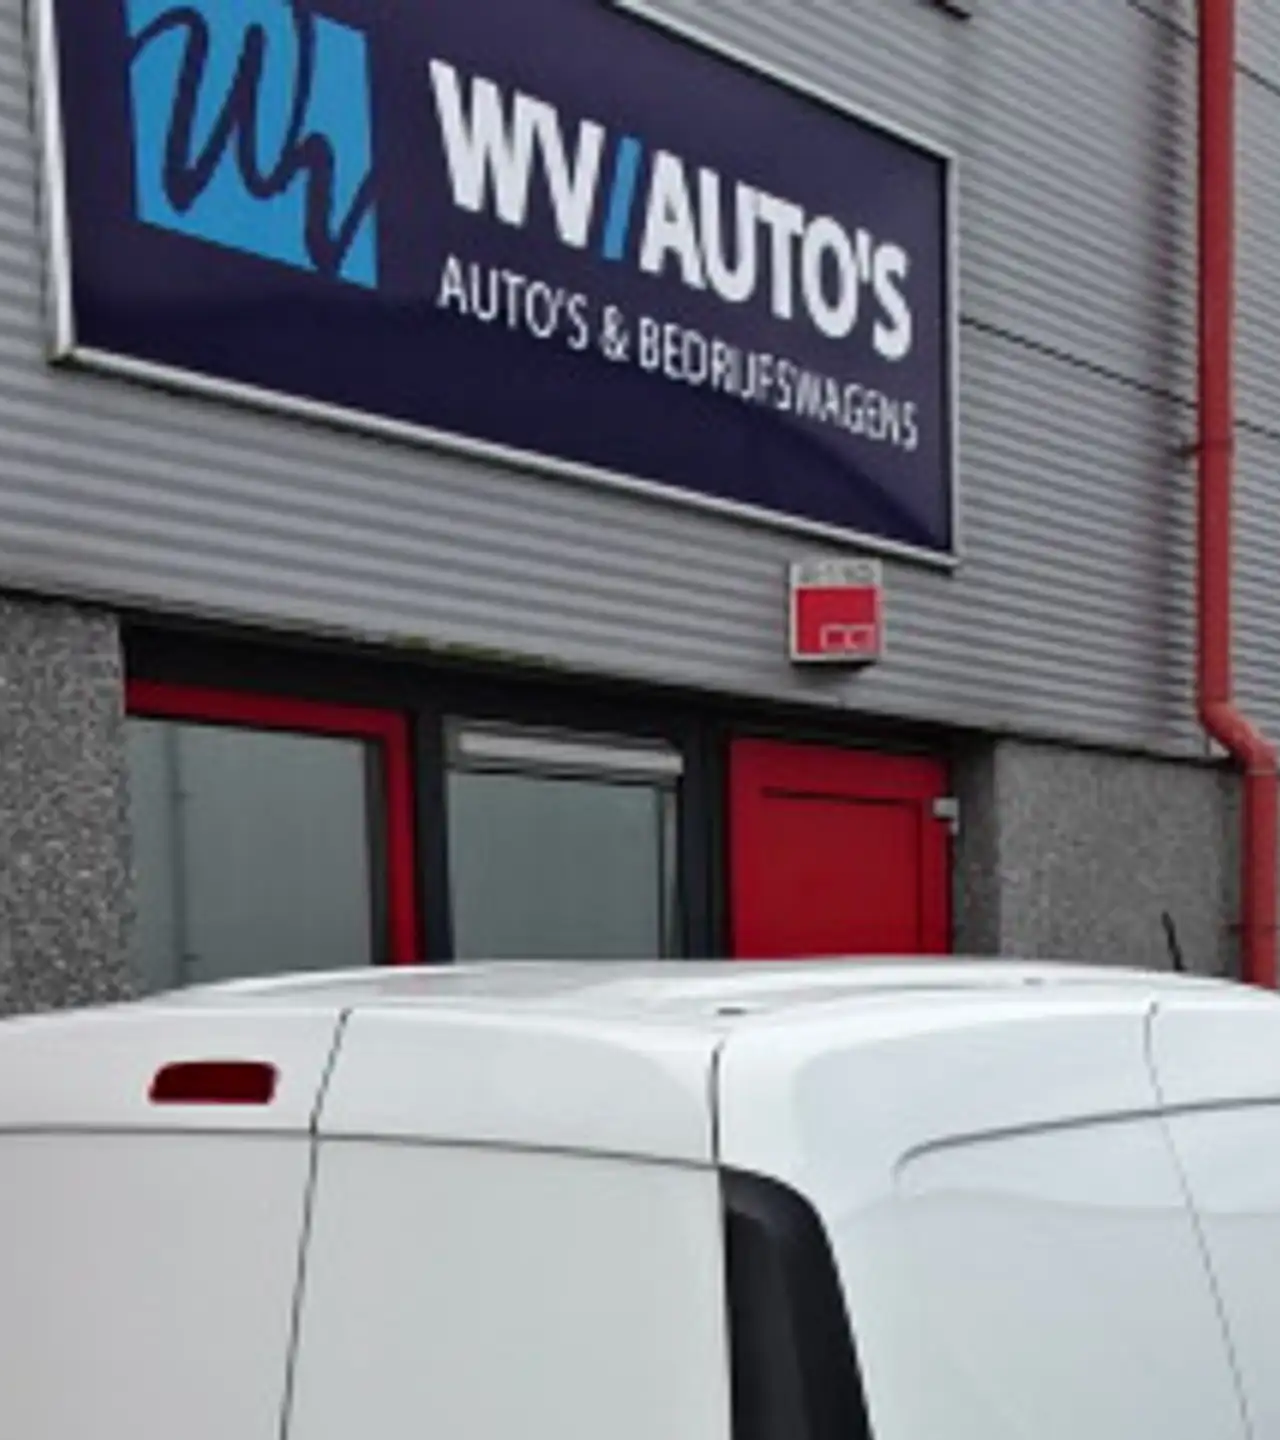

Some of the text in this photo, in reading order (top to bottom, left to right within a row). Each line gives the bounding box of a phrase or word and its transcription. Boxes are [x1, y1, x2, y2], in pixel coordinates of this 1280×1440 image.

[437, 254, 919, 453] AUTO'S & BEDRIJFSWAGENS
